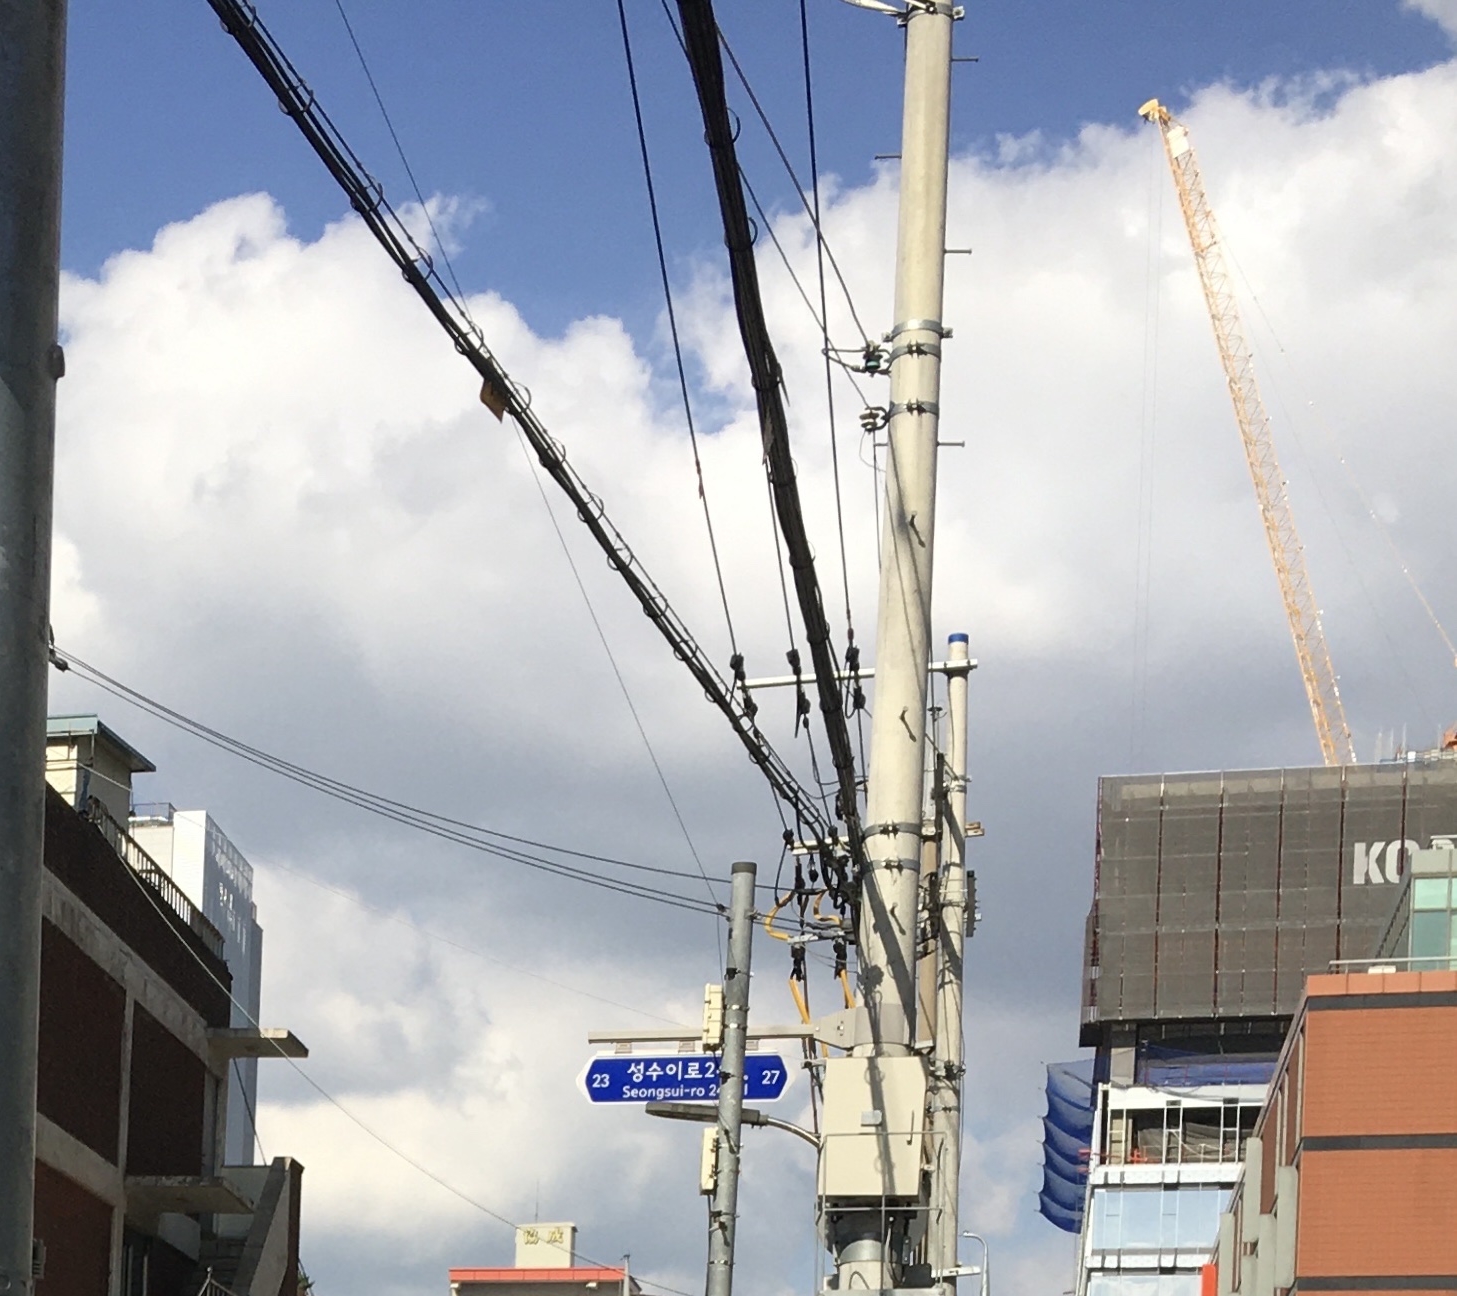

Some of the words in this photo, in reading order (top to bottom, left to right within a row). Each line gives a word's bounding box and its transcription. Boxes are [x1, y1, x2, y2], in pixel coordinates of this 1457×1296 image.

[592, 1074, 610, 1088] 23
[762, 1070, 780, 1085] 27
[622, 1085, 705, 1100] Seongsui-ro
